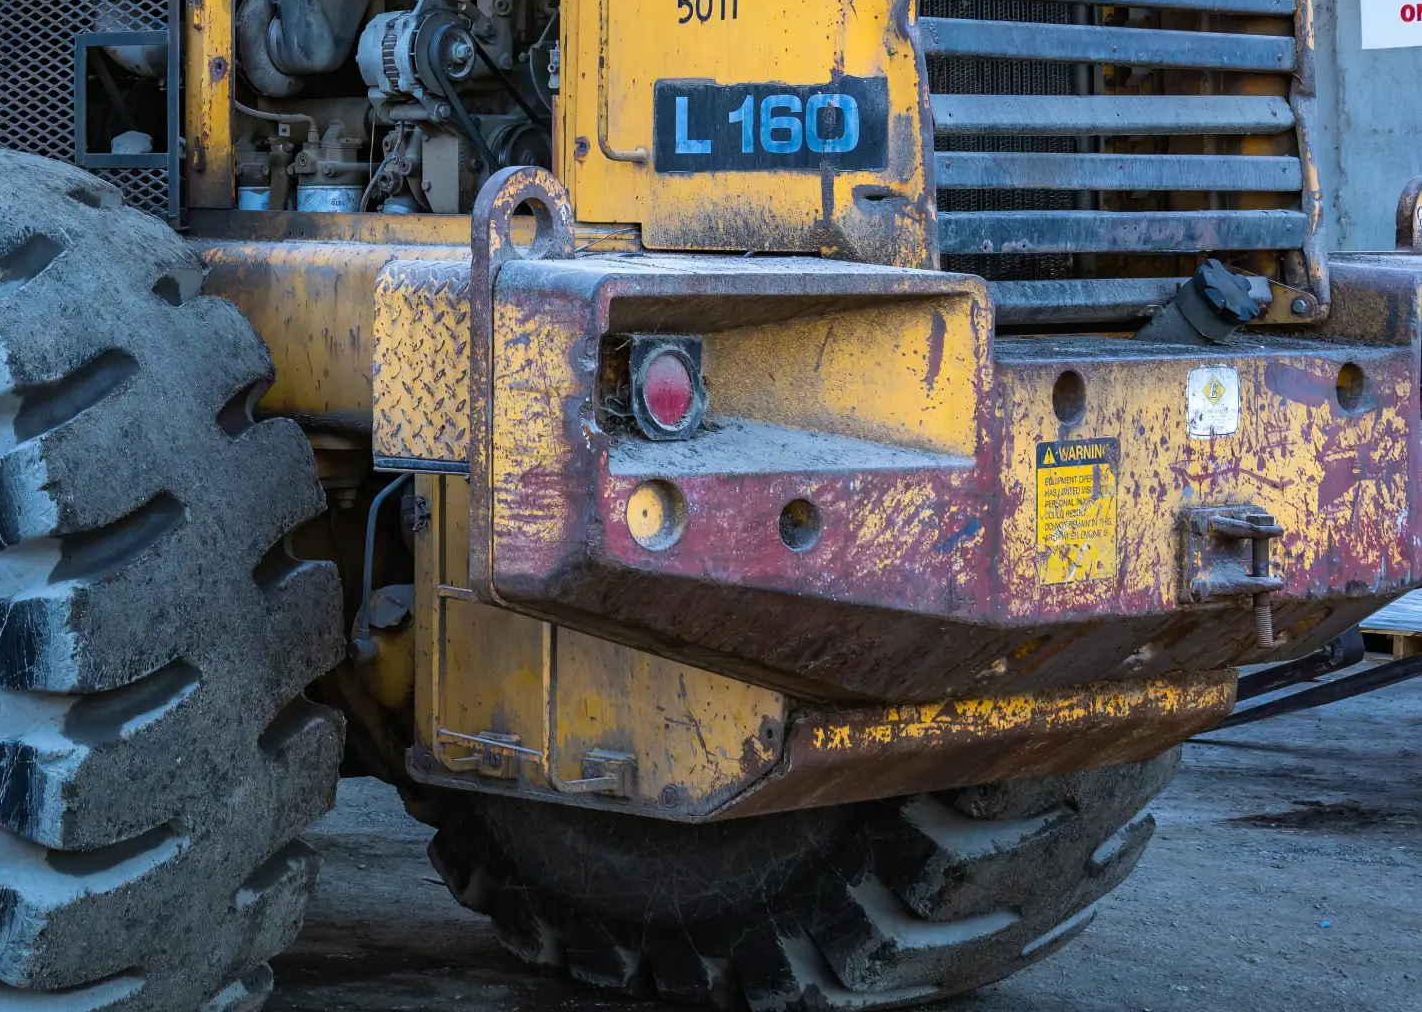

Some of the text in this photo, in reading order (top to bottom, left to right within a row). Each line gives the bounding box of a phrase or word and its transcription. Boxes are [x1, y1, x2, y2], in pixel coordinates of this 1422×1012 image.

[675, 94, 860, 154] L 160
[1058, 443, 1108, 462] WARNIN
[1045, 475, 1077, 486] EQUIPMENT
[1099, 517, 1111, 526] THIS
